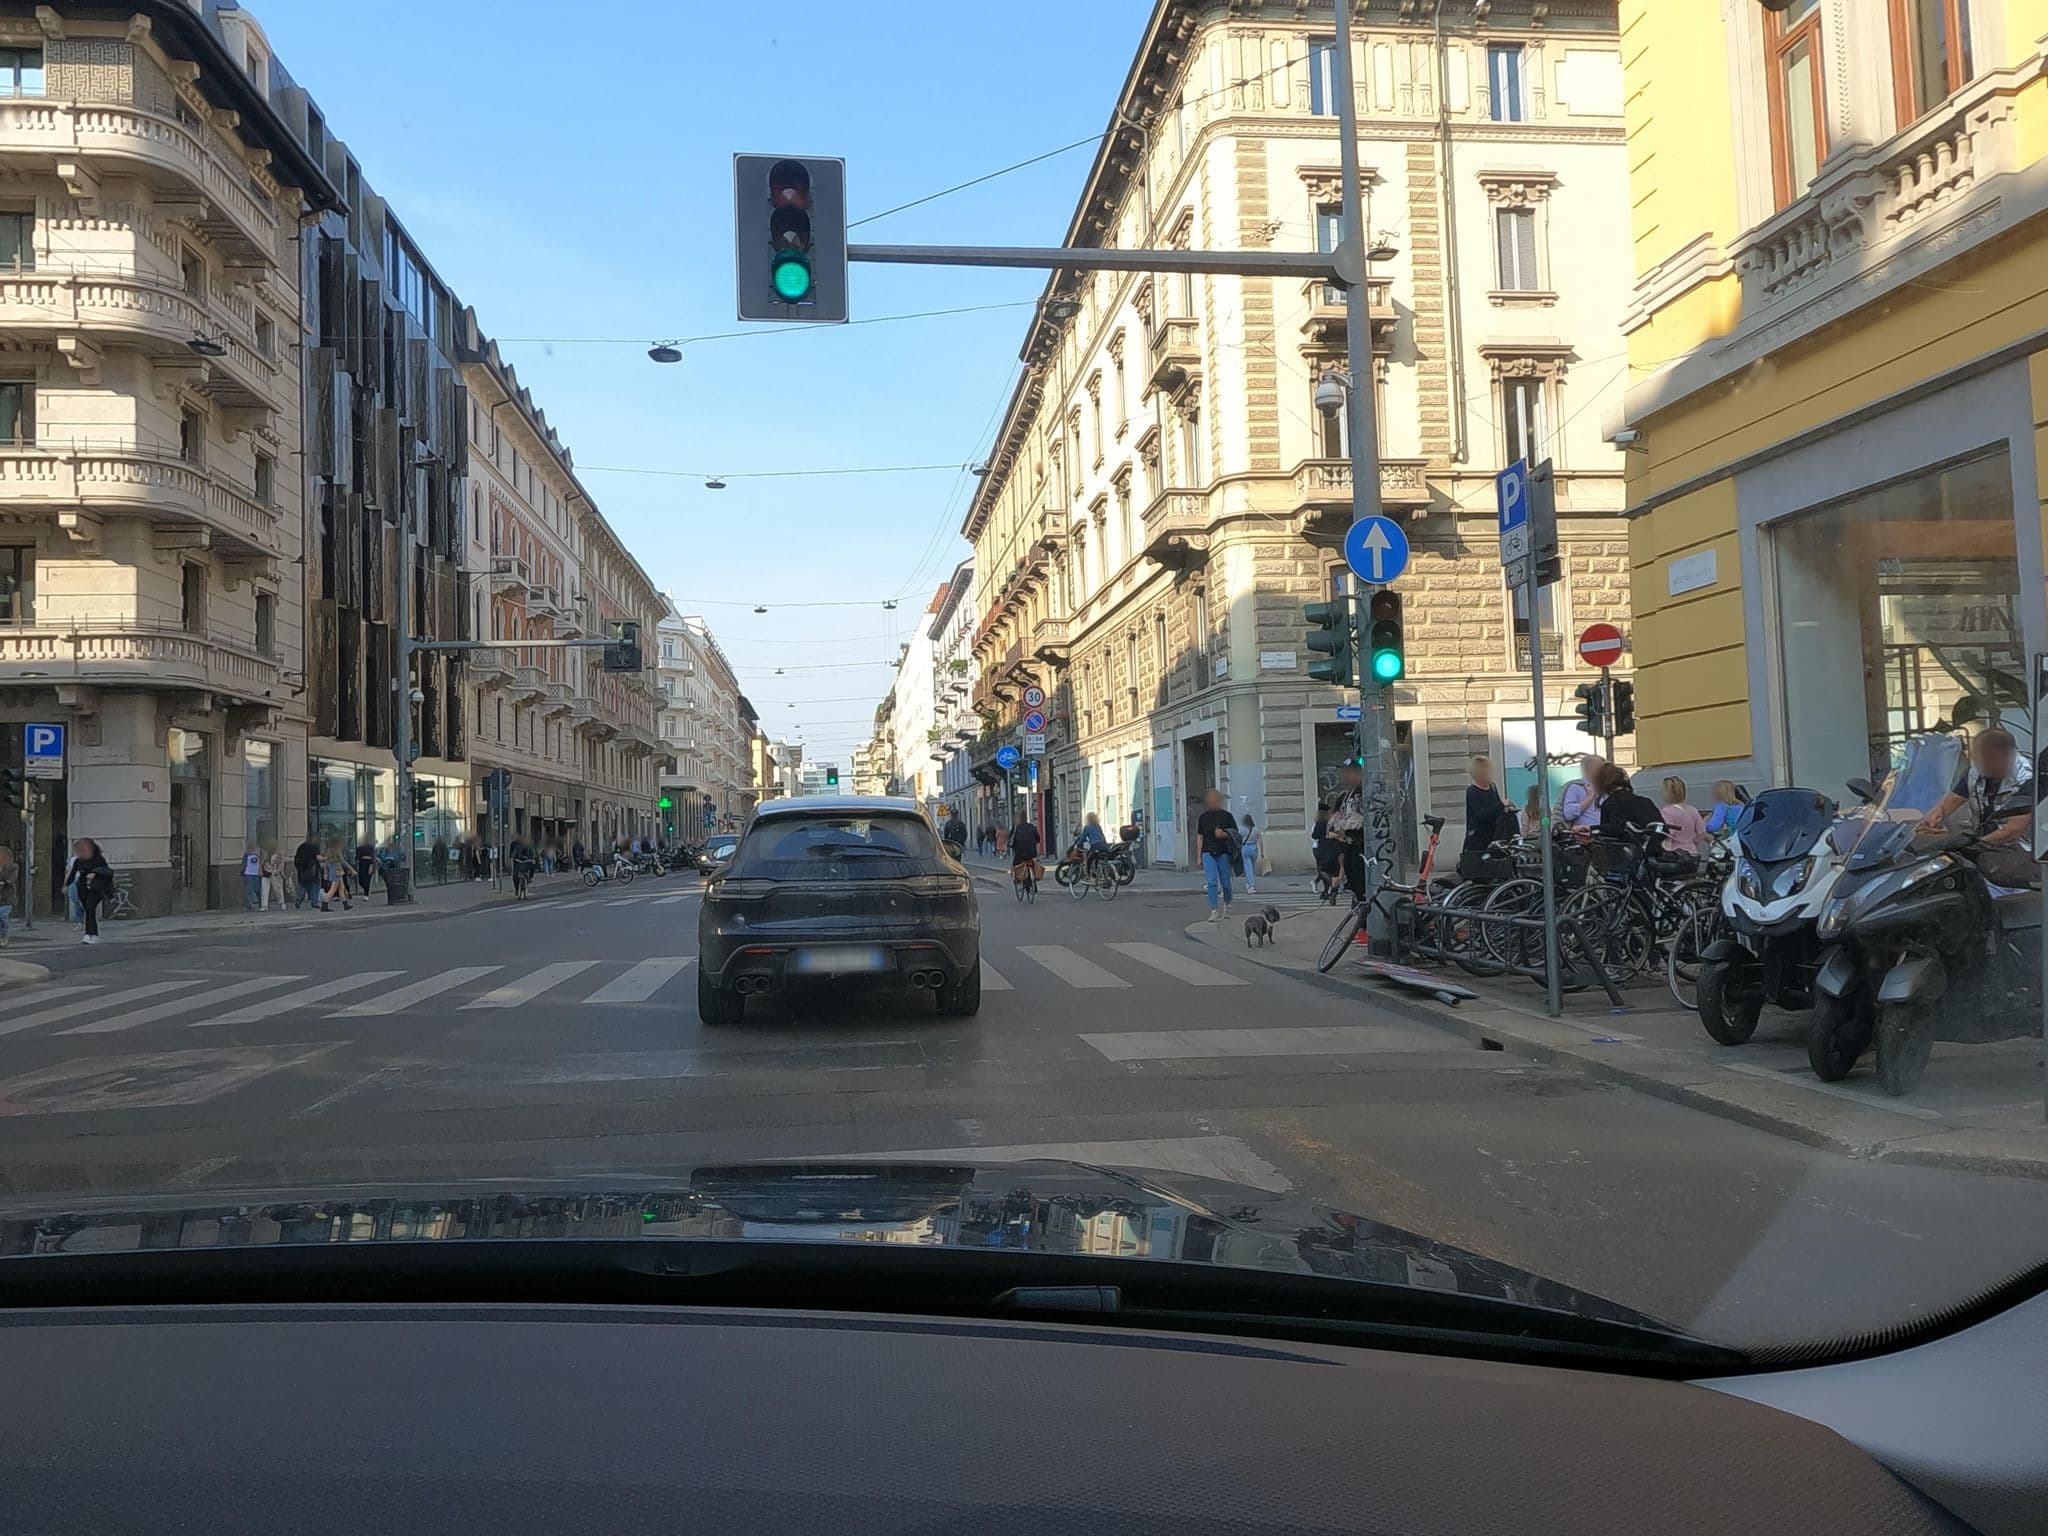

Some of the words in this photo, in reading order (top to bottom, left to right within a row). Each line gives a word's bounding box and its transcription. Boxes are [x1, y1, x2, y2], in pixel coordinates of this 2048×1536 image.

[1502, 472, 1520, 526] P
[1028, 692, 1041, 702] 30
[34, 728, 55, 753] P
